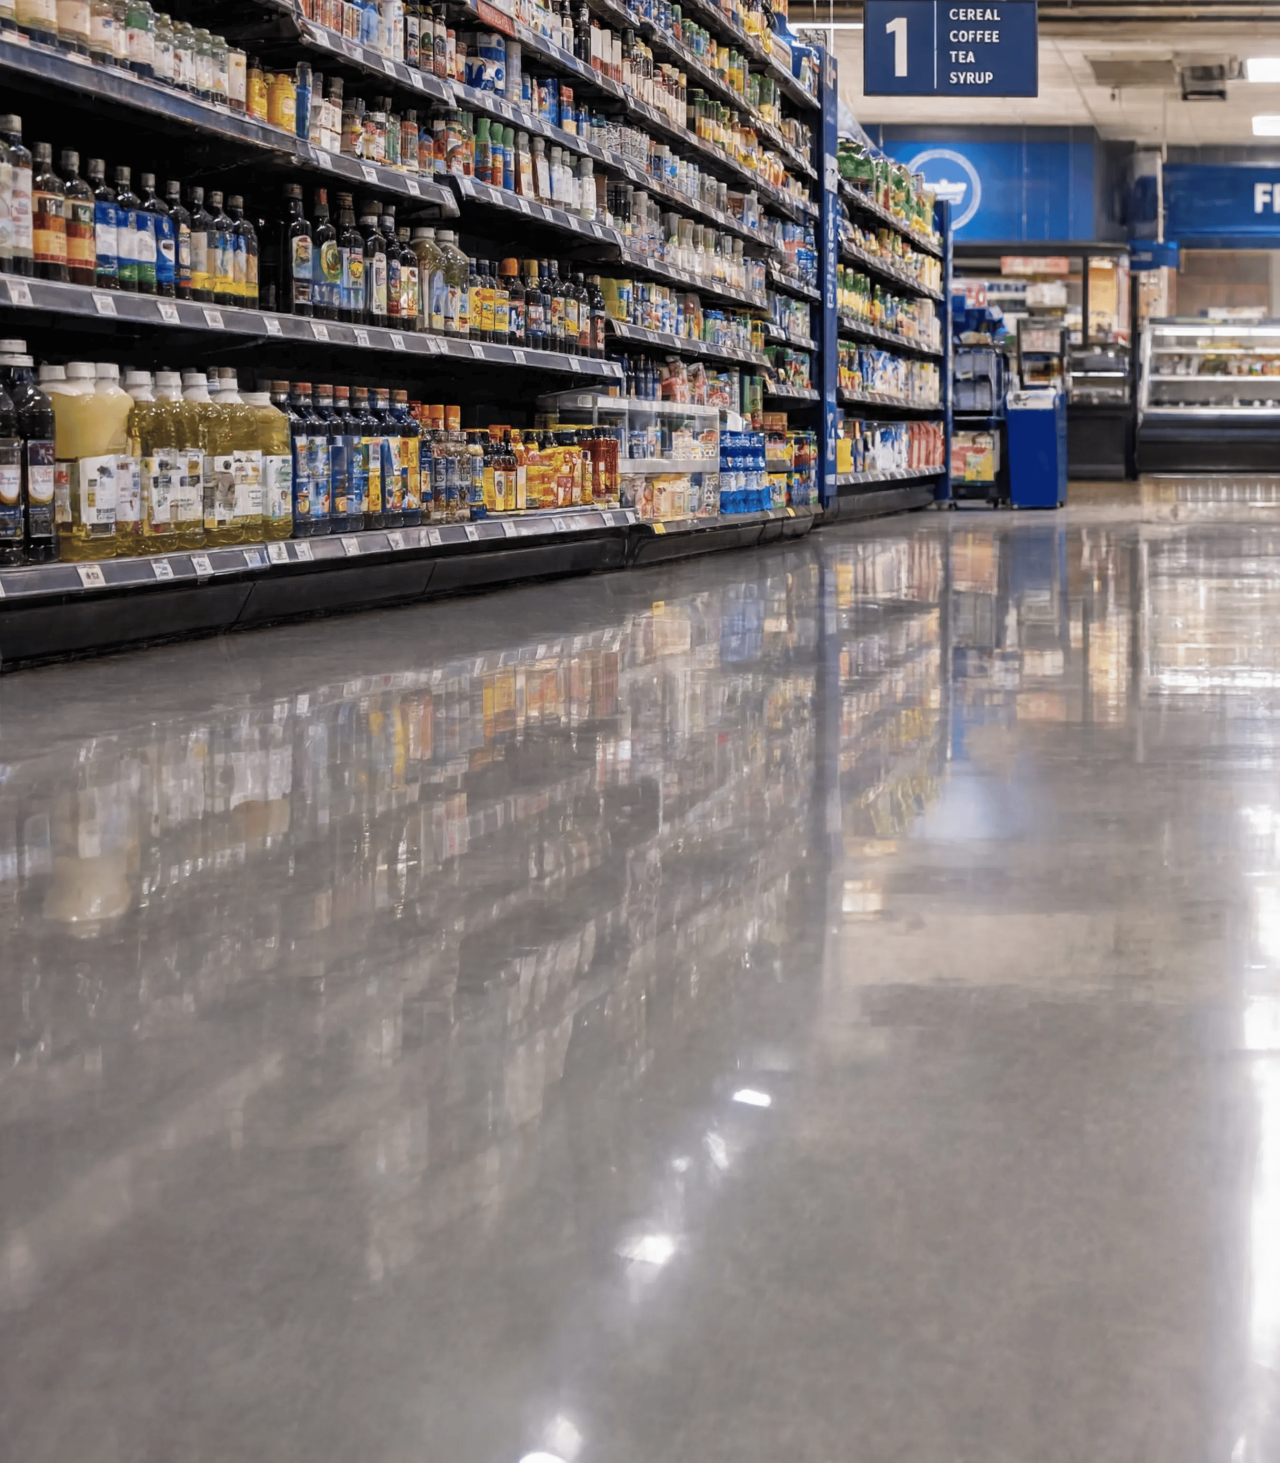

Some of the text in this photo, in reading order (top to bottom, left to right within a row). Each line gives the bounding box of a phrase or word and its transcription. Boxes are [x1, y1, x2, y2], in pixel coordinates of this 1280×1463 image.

[949, 8, 1001, 21] CEREAL
[949, 30, 1000, 43] COFFEE
[885, 17, 908, 78] 1
[949, 51, 976, 63] TEA
[949, 71, 994, 84] SYRUP
